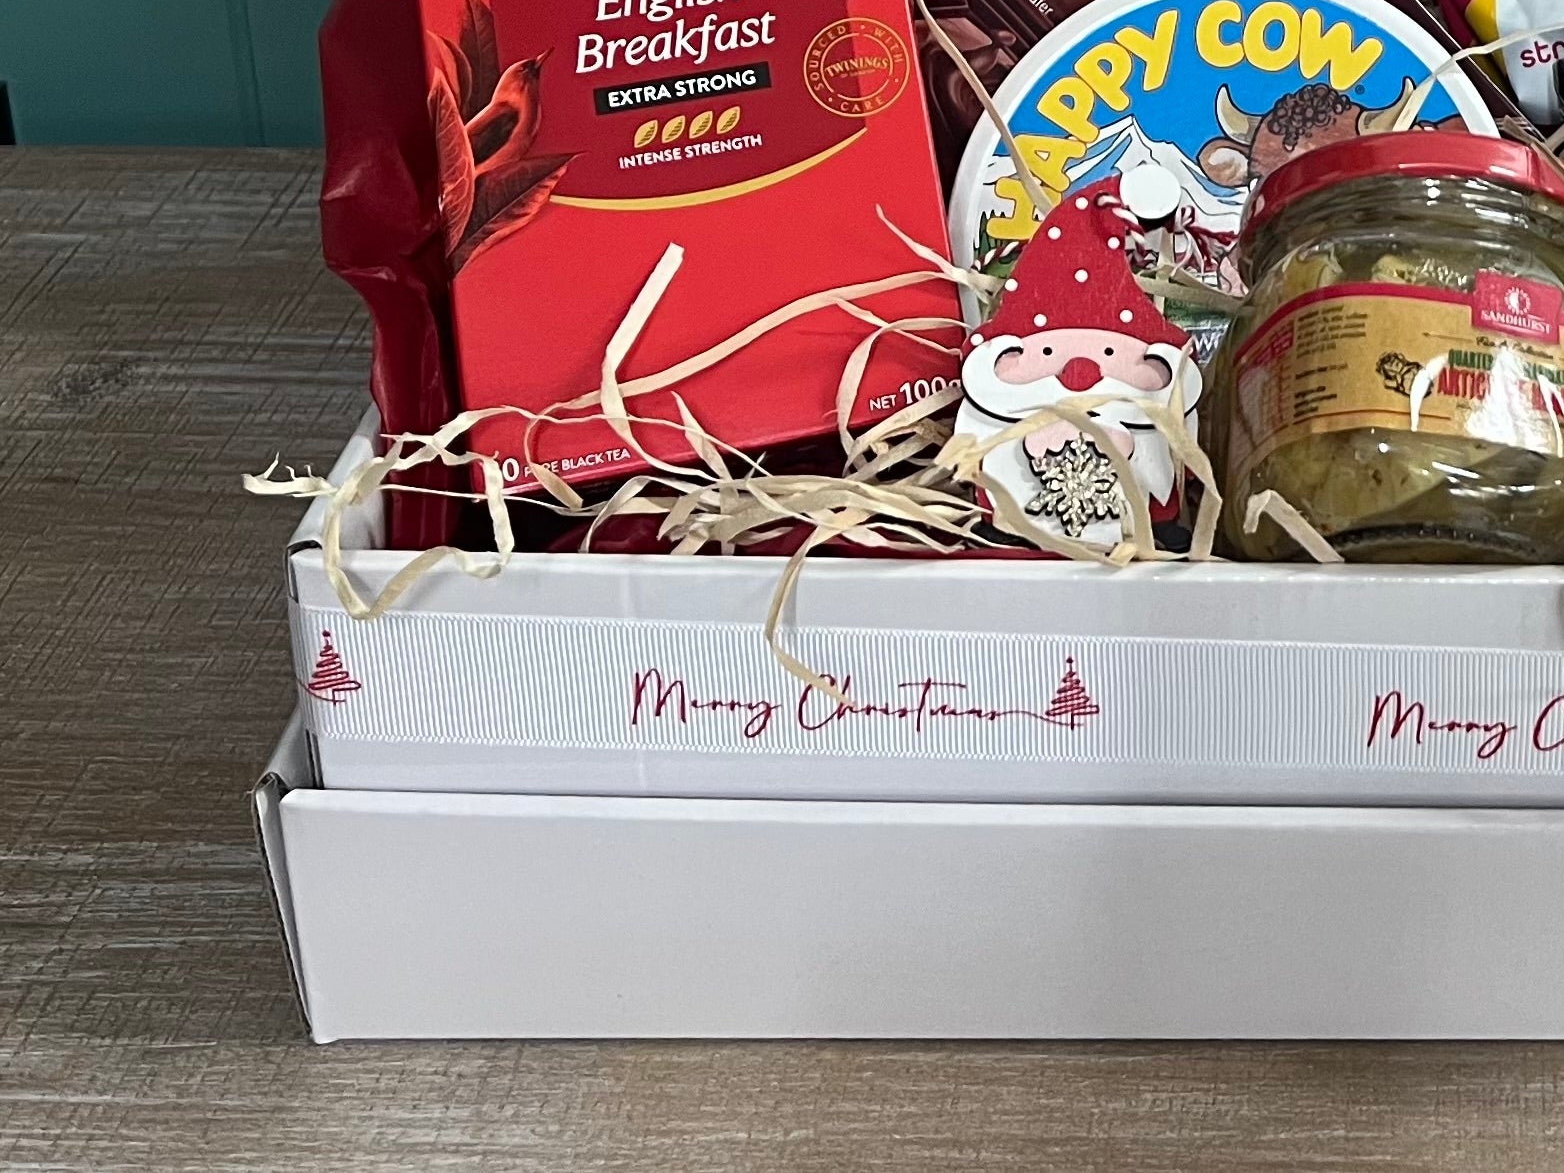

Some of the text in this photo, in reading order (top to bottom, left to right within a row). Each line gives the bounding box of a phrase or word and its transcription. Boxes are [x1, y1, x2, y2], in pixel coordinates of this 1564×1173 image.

[574, 10, 777, 74] Breakfast
[809, 25, 904, 91] SOURCED WITH
[824, 56, 889, 78] TWININGS
[607, 69, 758, 108] EXTRA STRONG
[840, 97, 883, 113] CARE
[986, 0, 1384, 242] HAPPY COW
[618, 133, 763, 170] INTENSE STRENGTH
[1480, 309, 1552, 334] SANDHURST
[869, 394, 897, 412] NET
[561, 452, 604, 471] BLACK
[605, 447, 632, 463] TEA
[631, 667, 1010, 740] Merry Christmas
[1366, 689, 1519, 760] Merry
